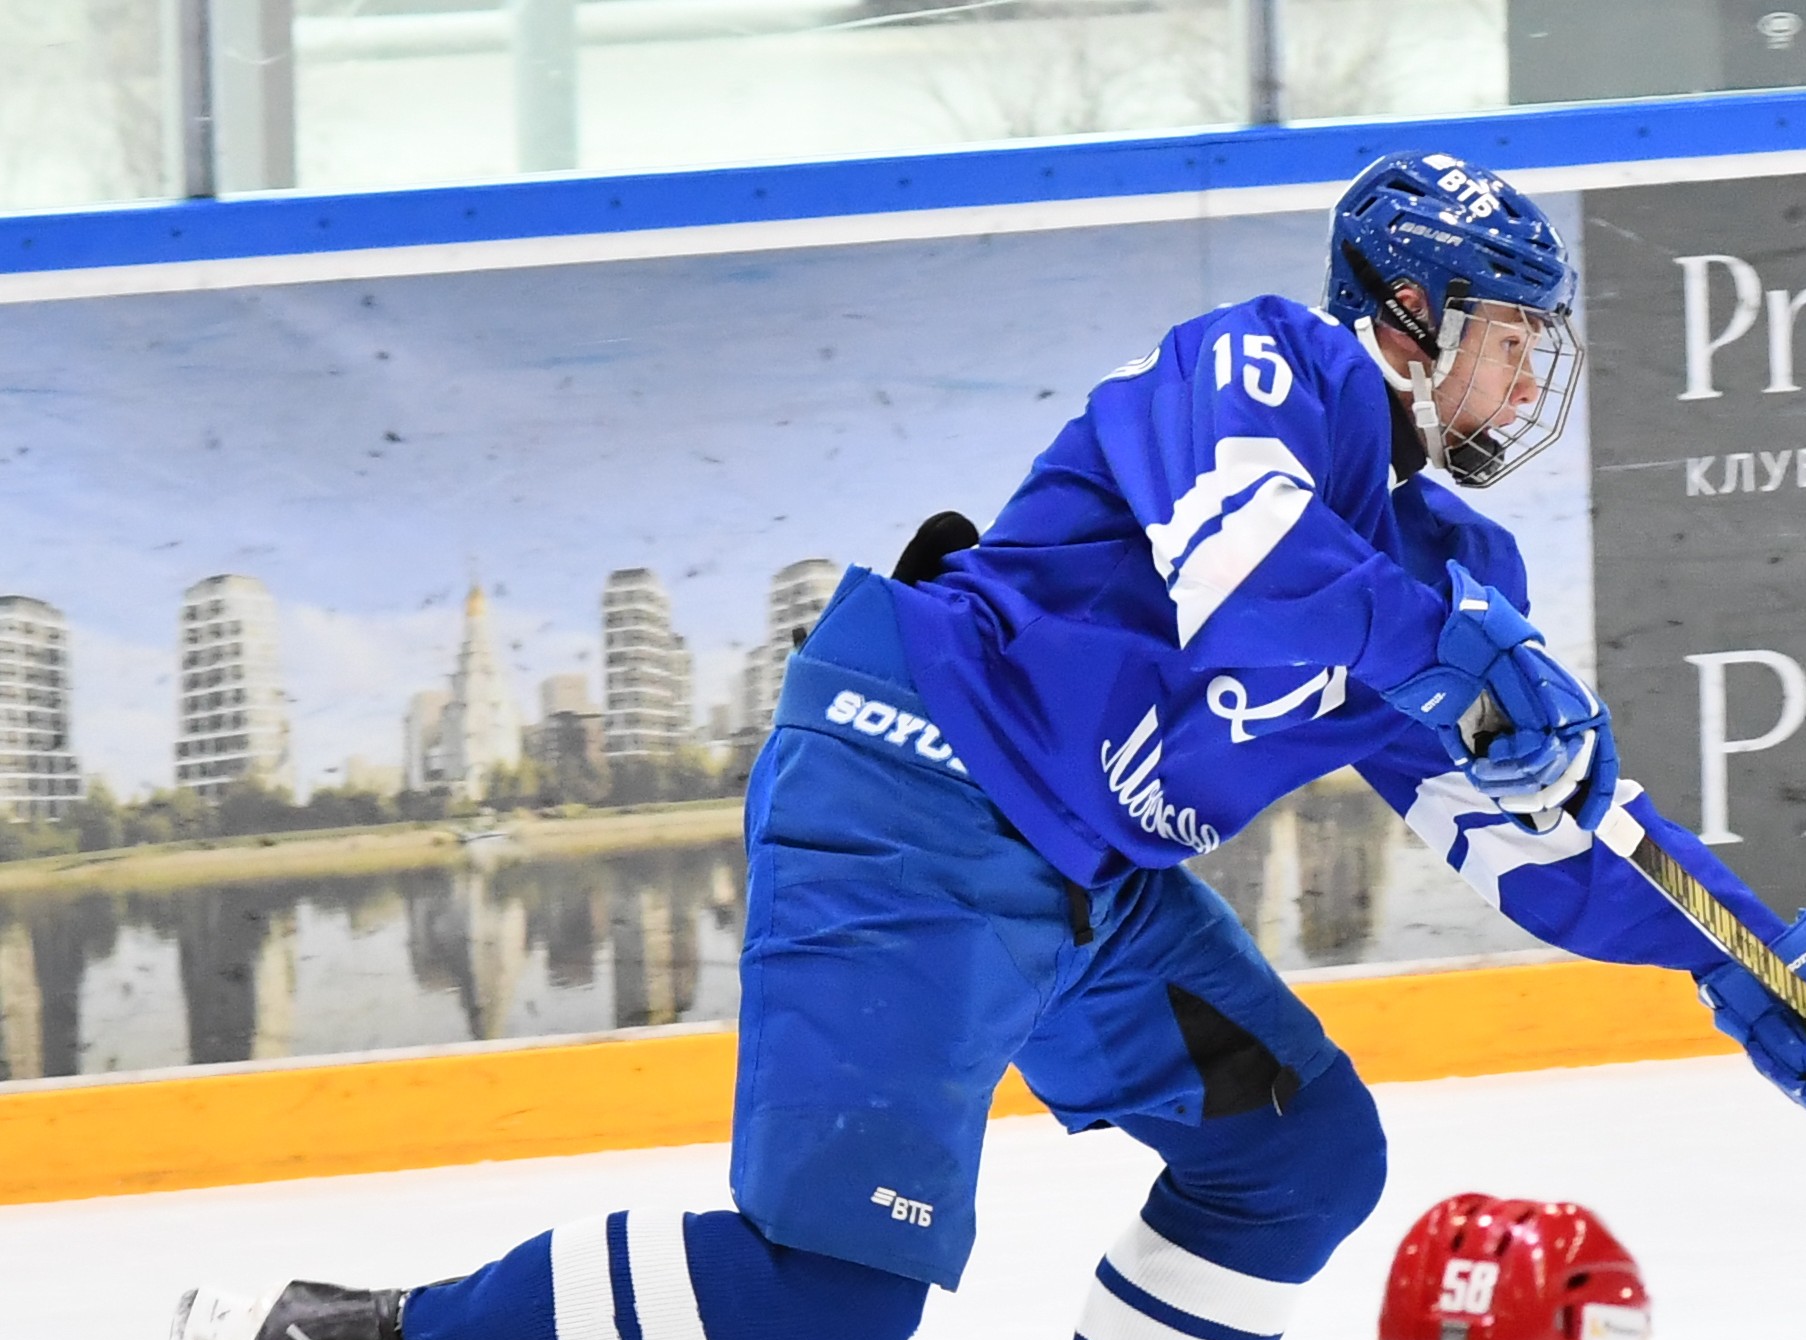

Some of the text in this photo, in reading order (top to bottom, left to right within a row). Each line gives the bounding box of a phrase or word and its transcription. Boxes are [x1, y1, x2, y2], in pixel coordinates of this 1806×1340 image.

[1437, 167, 1500, 218] ВТБ
[1212, 332, 1293, 407] 15
[891, 1196, 934, 1228] ВТБ
[1438, 1258, 1500, 1315] 58
